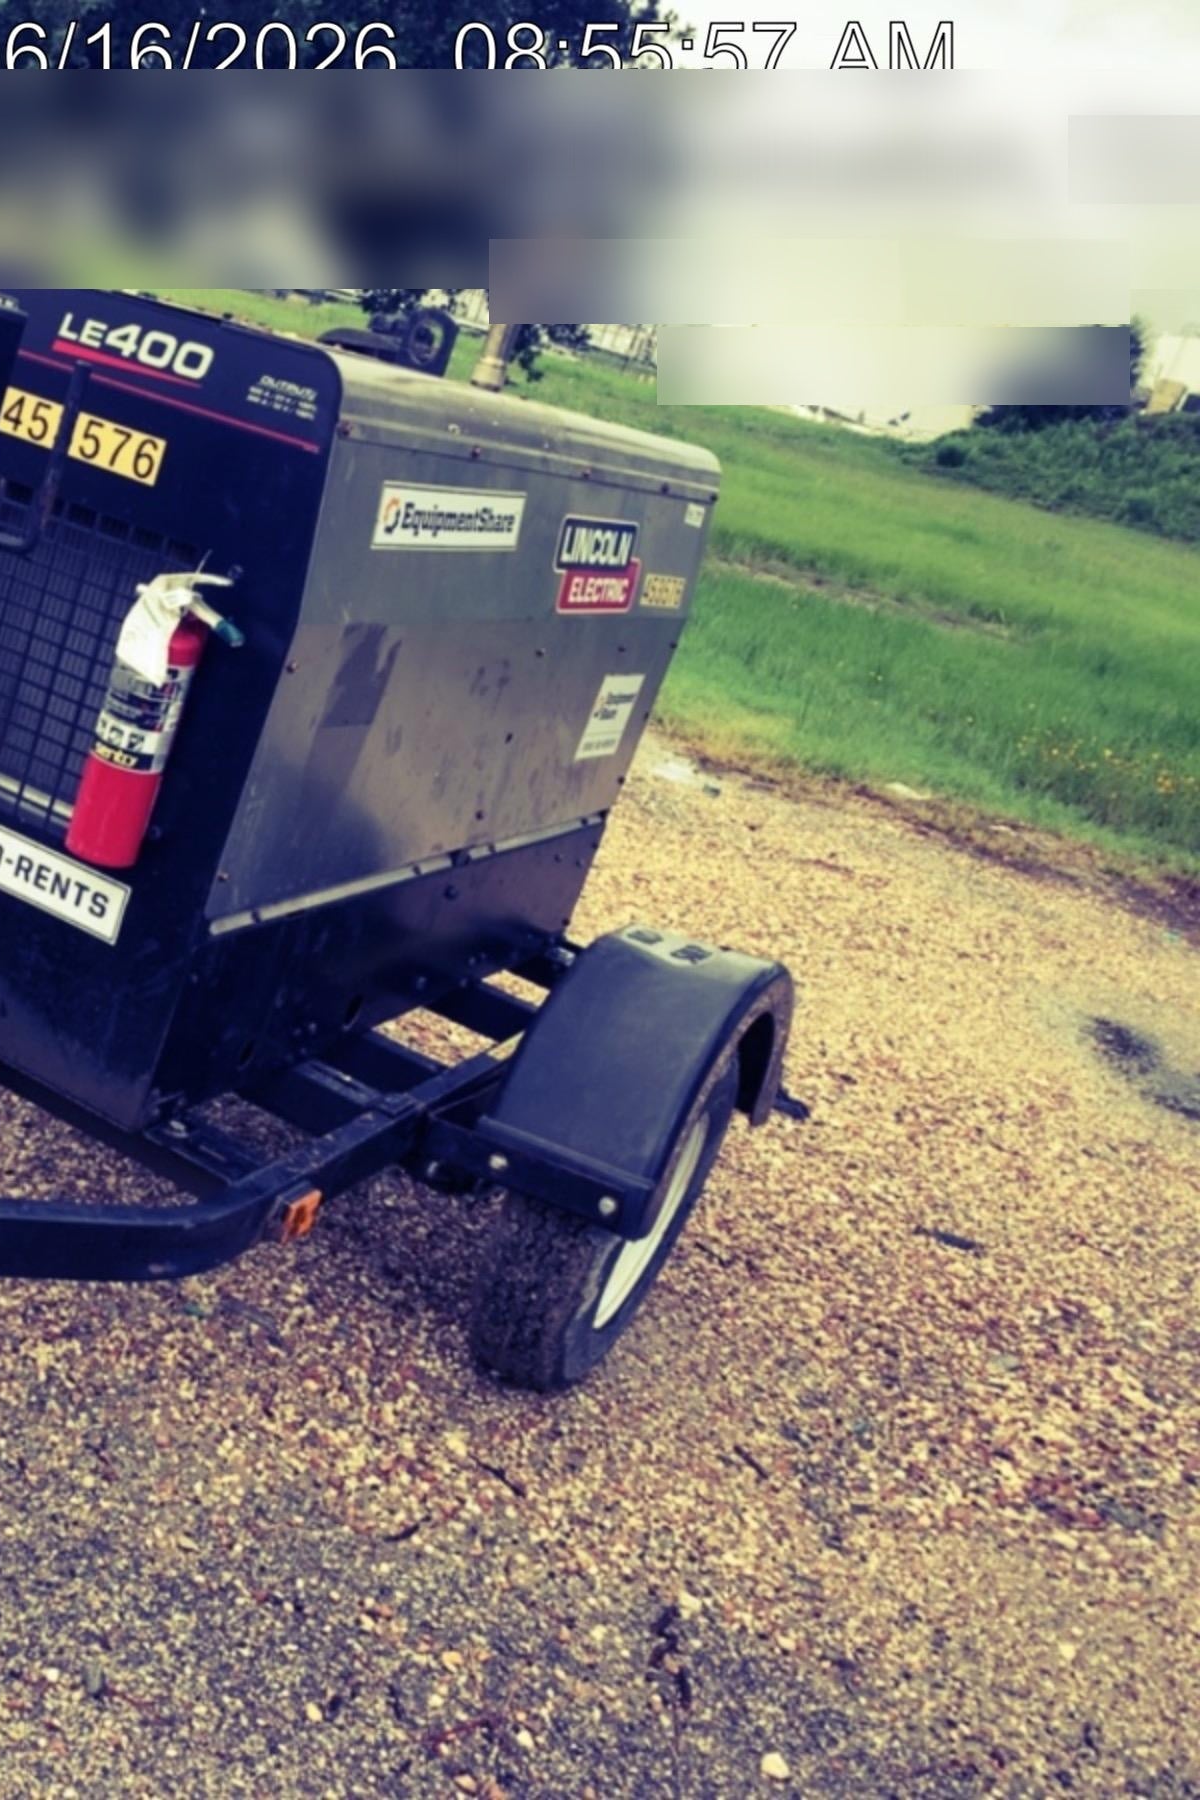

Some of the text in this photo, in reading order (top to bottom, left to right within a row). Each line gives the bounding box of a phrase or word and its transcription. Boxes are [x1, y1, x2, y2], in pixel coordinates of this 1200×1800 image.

[57, 312, 215, 380] LE400
[402, 502, 516, 537] EquipmentShare
[561, 525, 633, 566] LINCOLN
[568, 576, 629, 603] ELECTRIC
